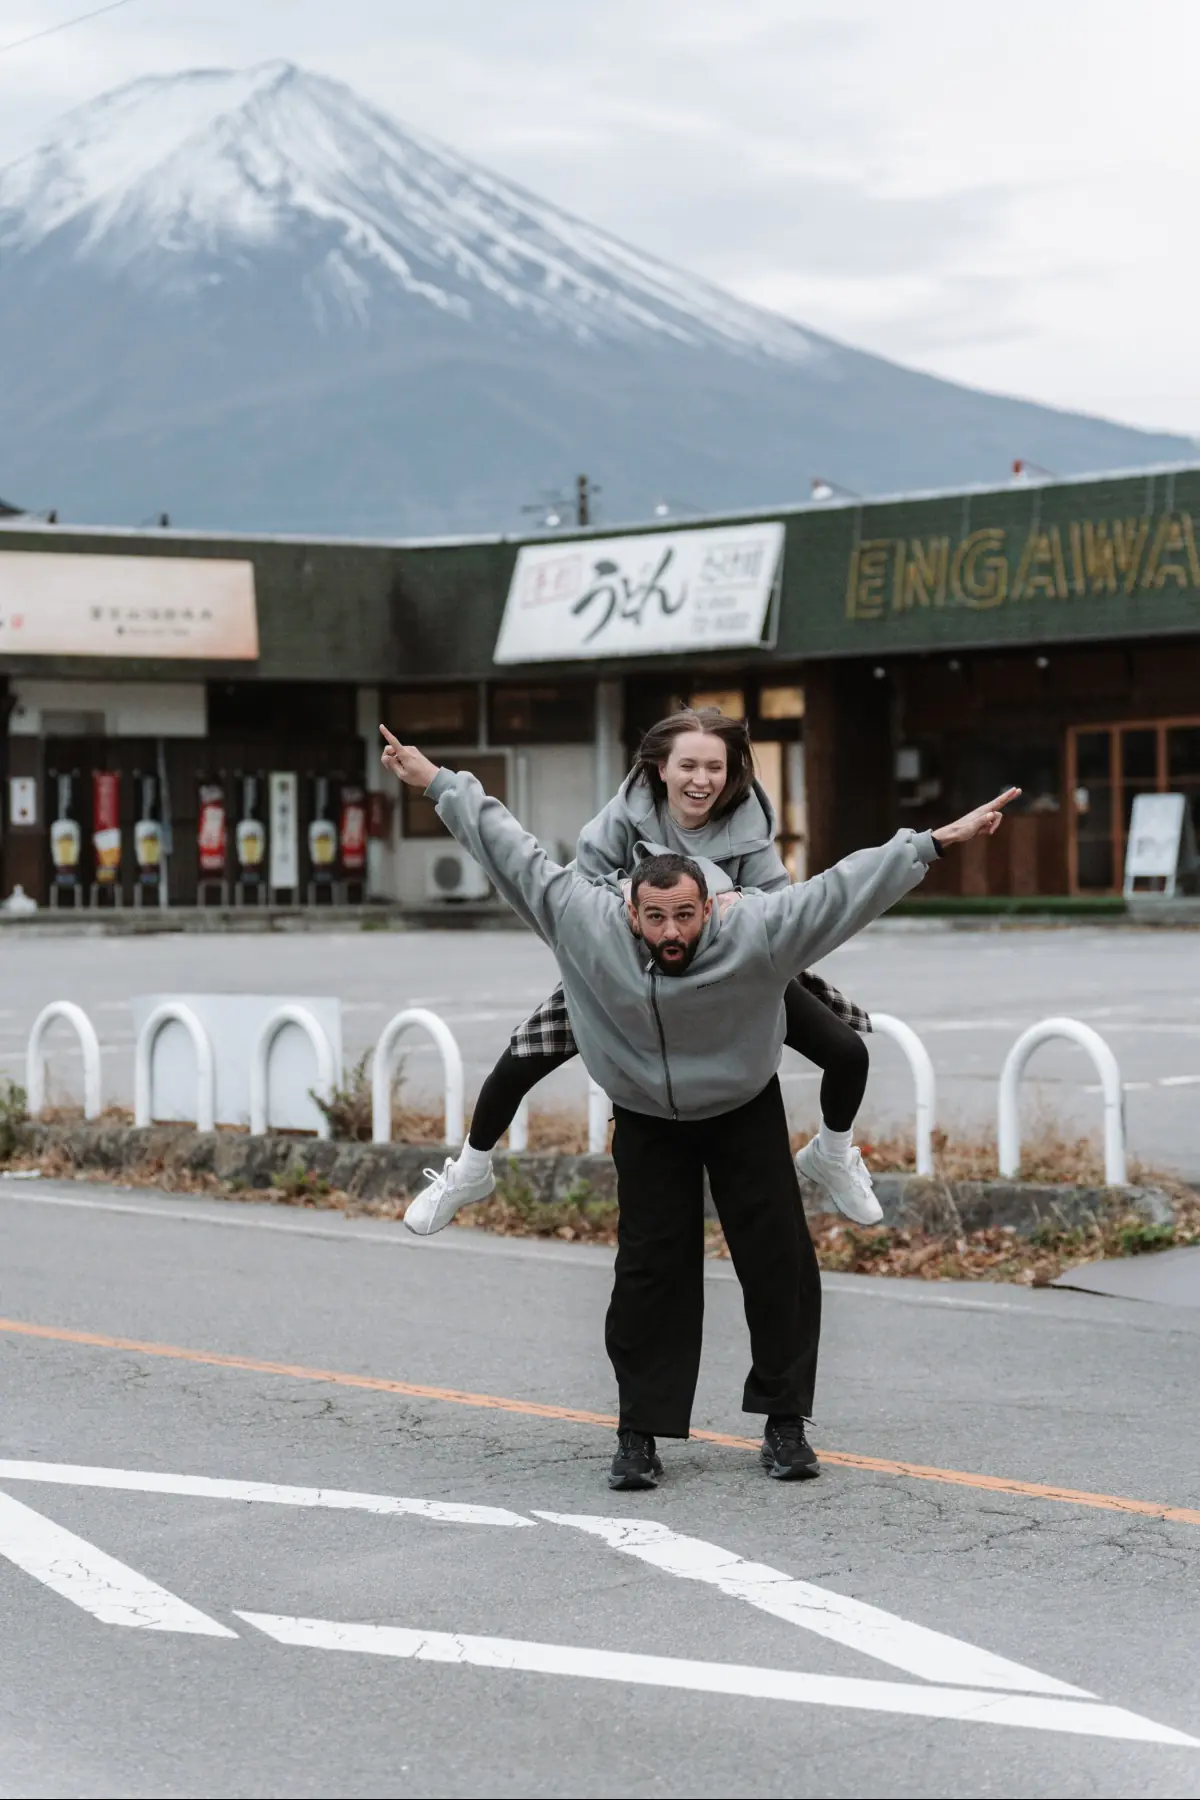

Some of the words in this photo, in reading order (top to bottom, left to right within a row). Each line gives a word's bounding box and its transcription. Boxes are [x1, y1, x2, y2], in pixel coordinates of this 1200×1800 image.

[572, 547, 689, 643] うどん
[846, 512, 1200, 620] ENGAWA
